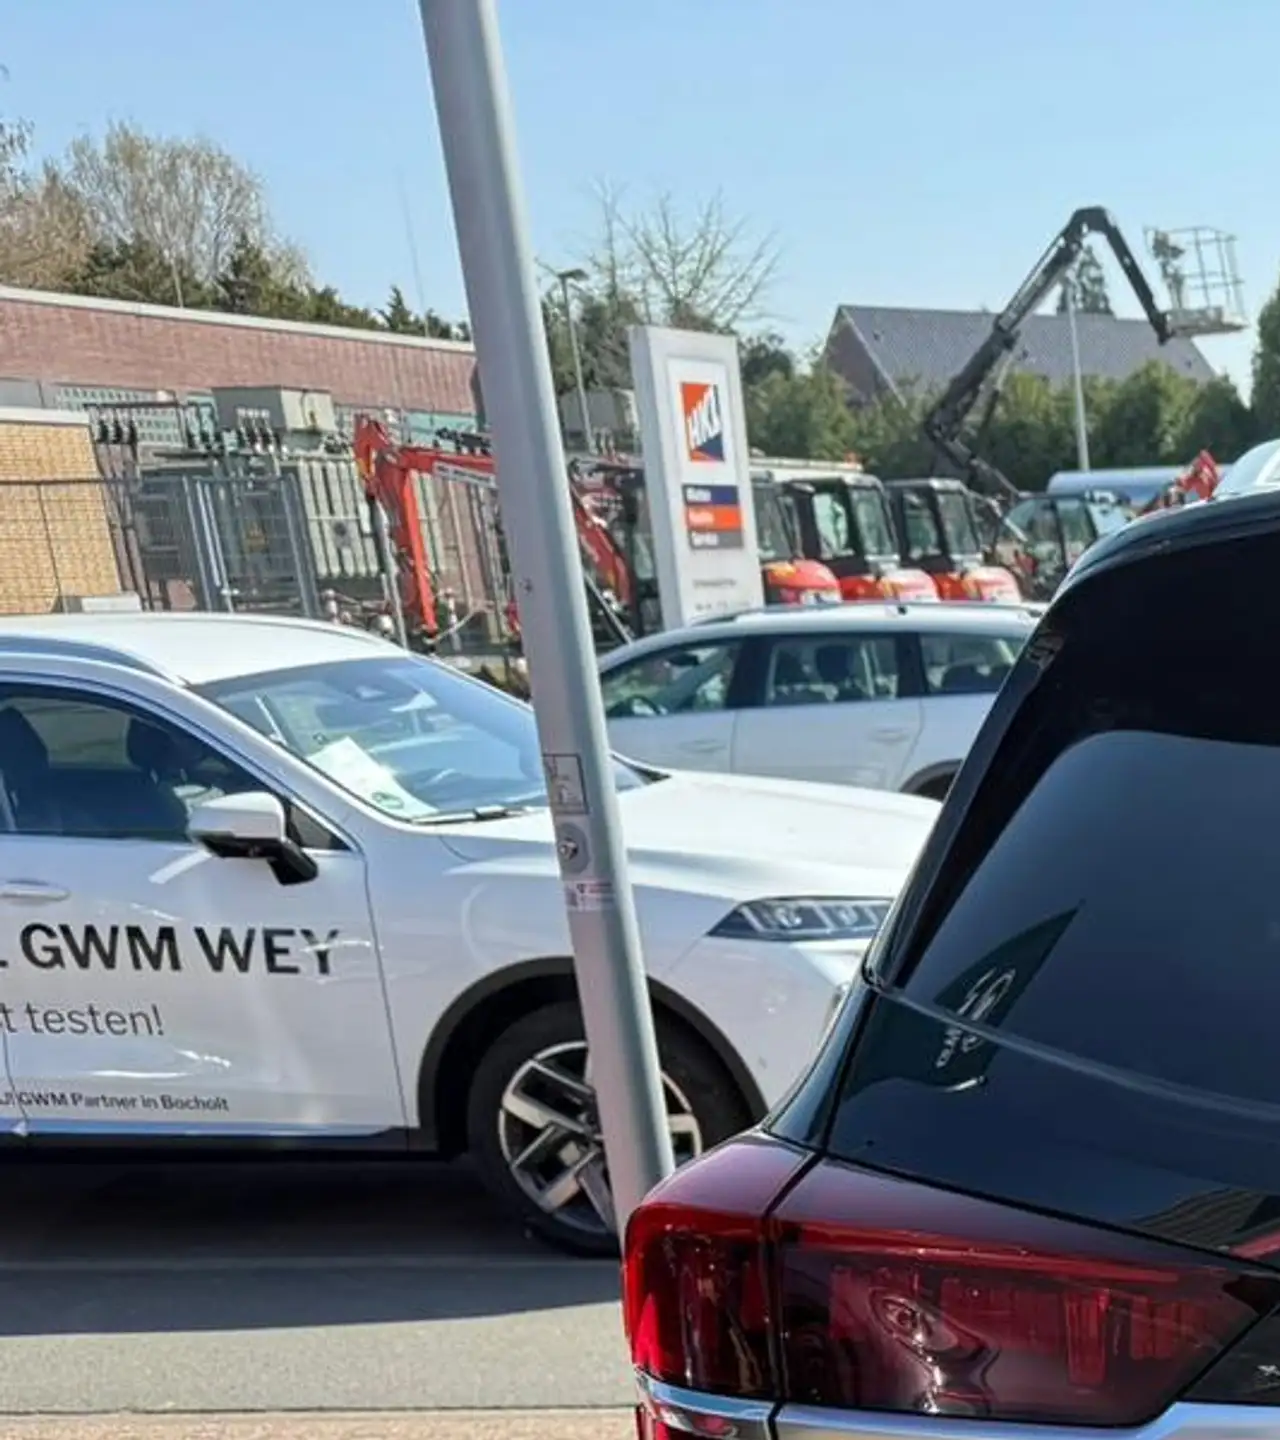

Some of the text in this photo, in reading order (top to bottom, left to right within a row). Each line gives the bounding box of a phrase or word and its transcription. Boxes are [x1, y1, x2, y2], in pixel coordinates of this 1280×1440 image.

[20, 924, 339, 975] GWM WEY
[25, 1002, 165, 1036] testen!
[20, 1091, 69, 1107] GWM
[71, 1092, 138, 1110] Partner
[141, 1094, 159, 1110] in
[163, 1094, 230, 1112] Bocholt
